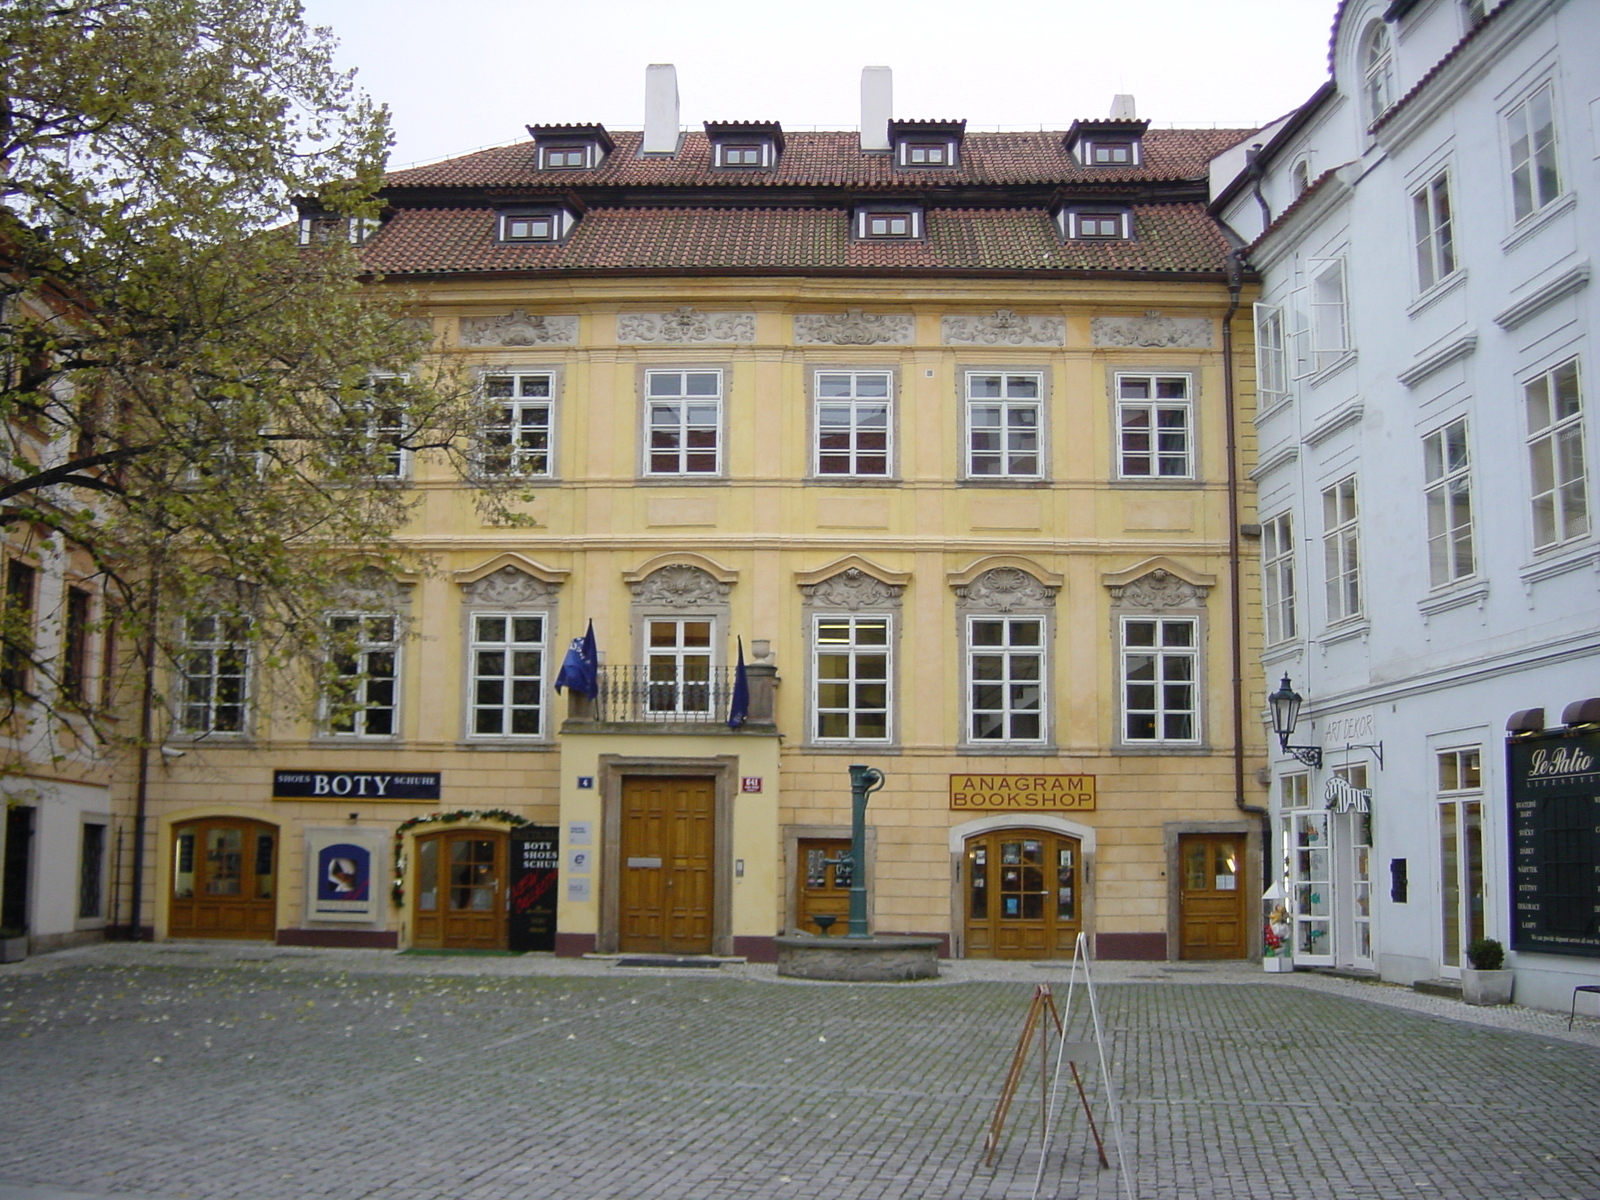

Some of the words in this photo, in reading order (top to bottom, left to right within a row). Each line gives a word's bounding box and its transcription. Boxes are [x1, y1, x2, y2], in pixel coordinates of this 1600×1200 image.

[1324, 720, 1342, 742] ART
[1343, 714, 1373, 740] DEKOR
[1528, 750, 1550, 777] Le
[1549, 747, 1594, 775] Patio
[278, 775, 311, 784] SHOES
[313, 774, 391, 796] BOTY
[394, 776, 436, 786] SCHUHE
[962, 777, 1084, 791] ANAGRAM
[1526, 775, 1600, 788] LIFESTYL
[953, 793, 1092, 807] BOOKSHOP
[523, 842, 552, 850] BOTY
[523, 851, 558, 860] SHOES
